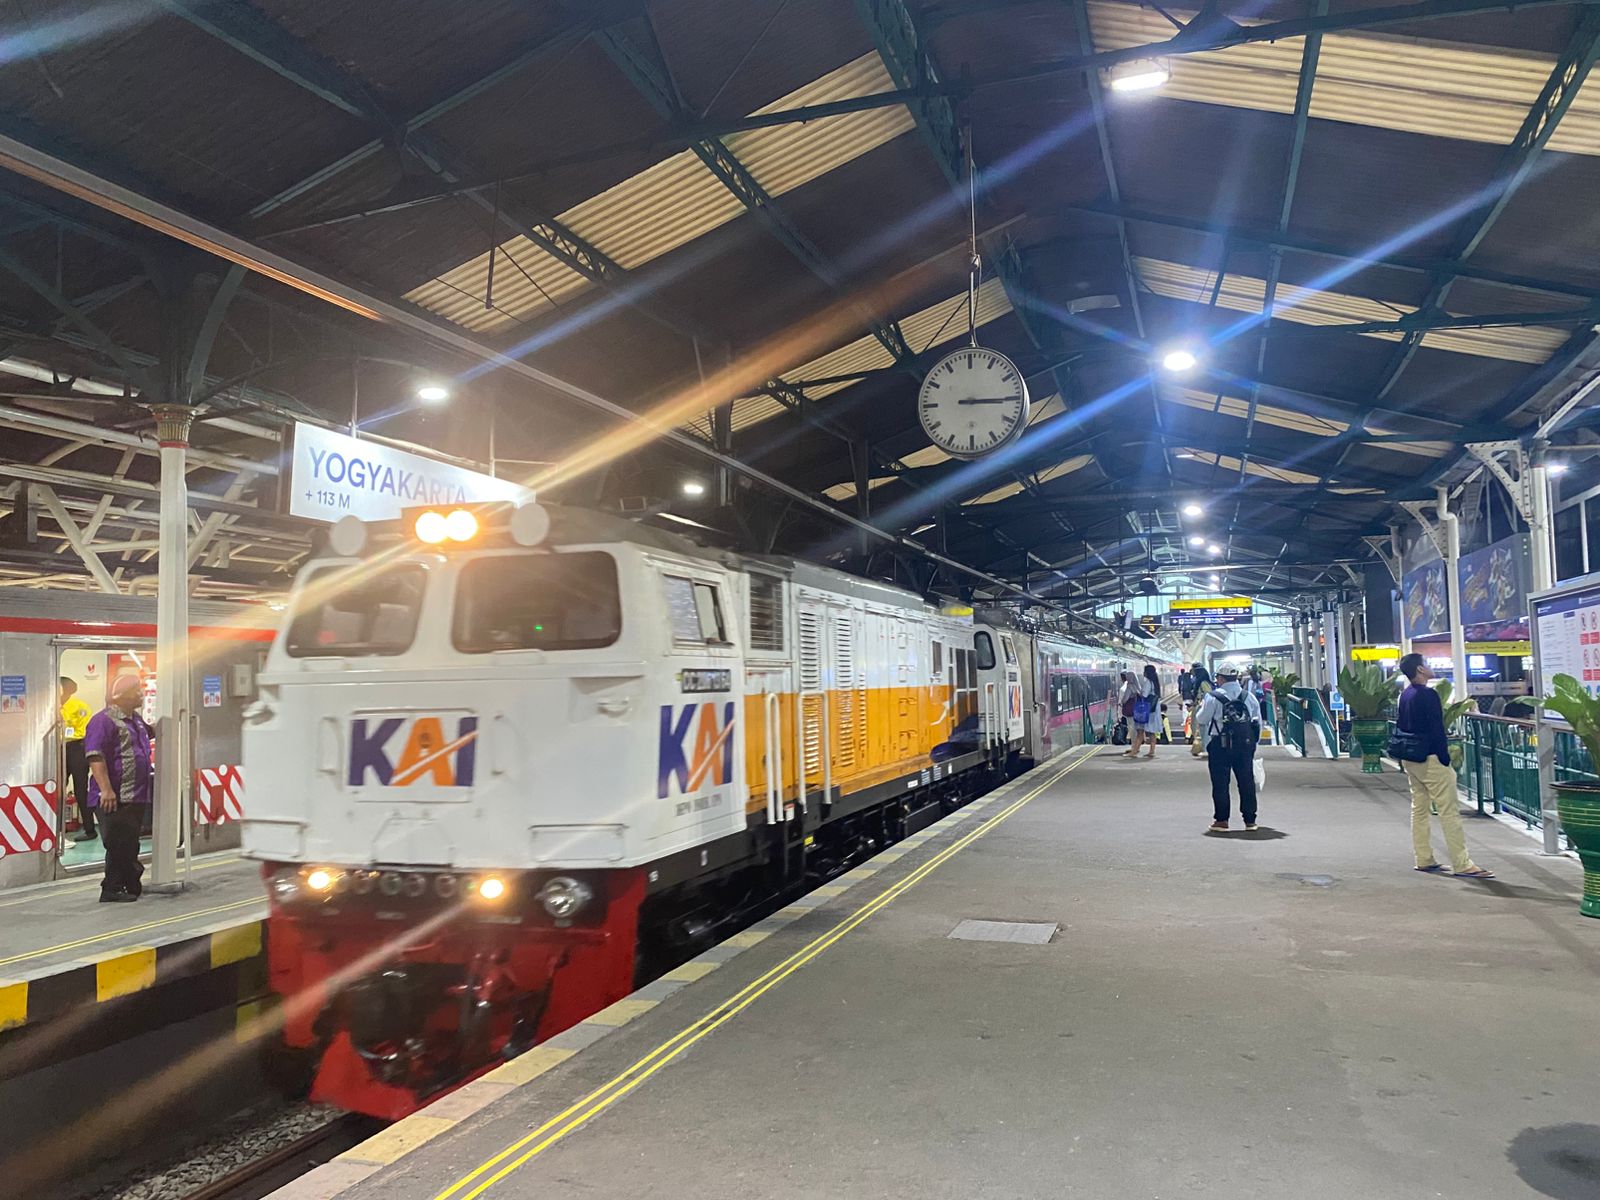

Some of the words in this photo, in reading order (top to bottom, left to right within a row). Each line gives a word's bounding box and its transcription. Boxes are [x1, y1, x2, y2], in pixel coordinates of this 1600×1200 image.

[309, 447, 466, 504] YOGYAKARTA
[317, 489, 335, 507] 113
[338, 494, 350, 509] M
[348, 716, 478, 787] KAI
[658, 701, 735, 799] KAI
